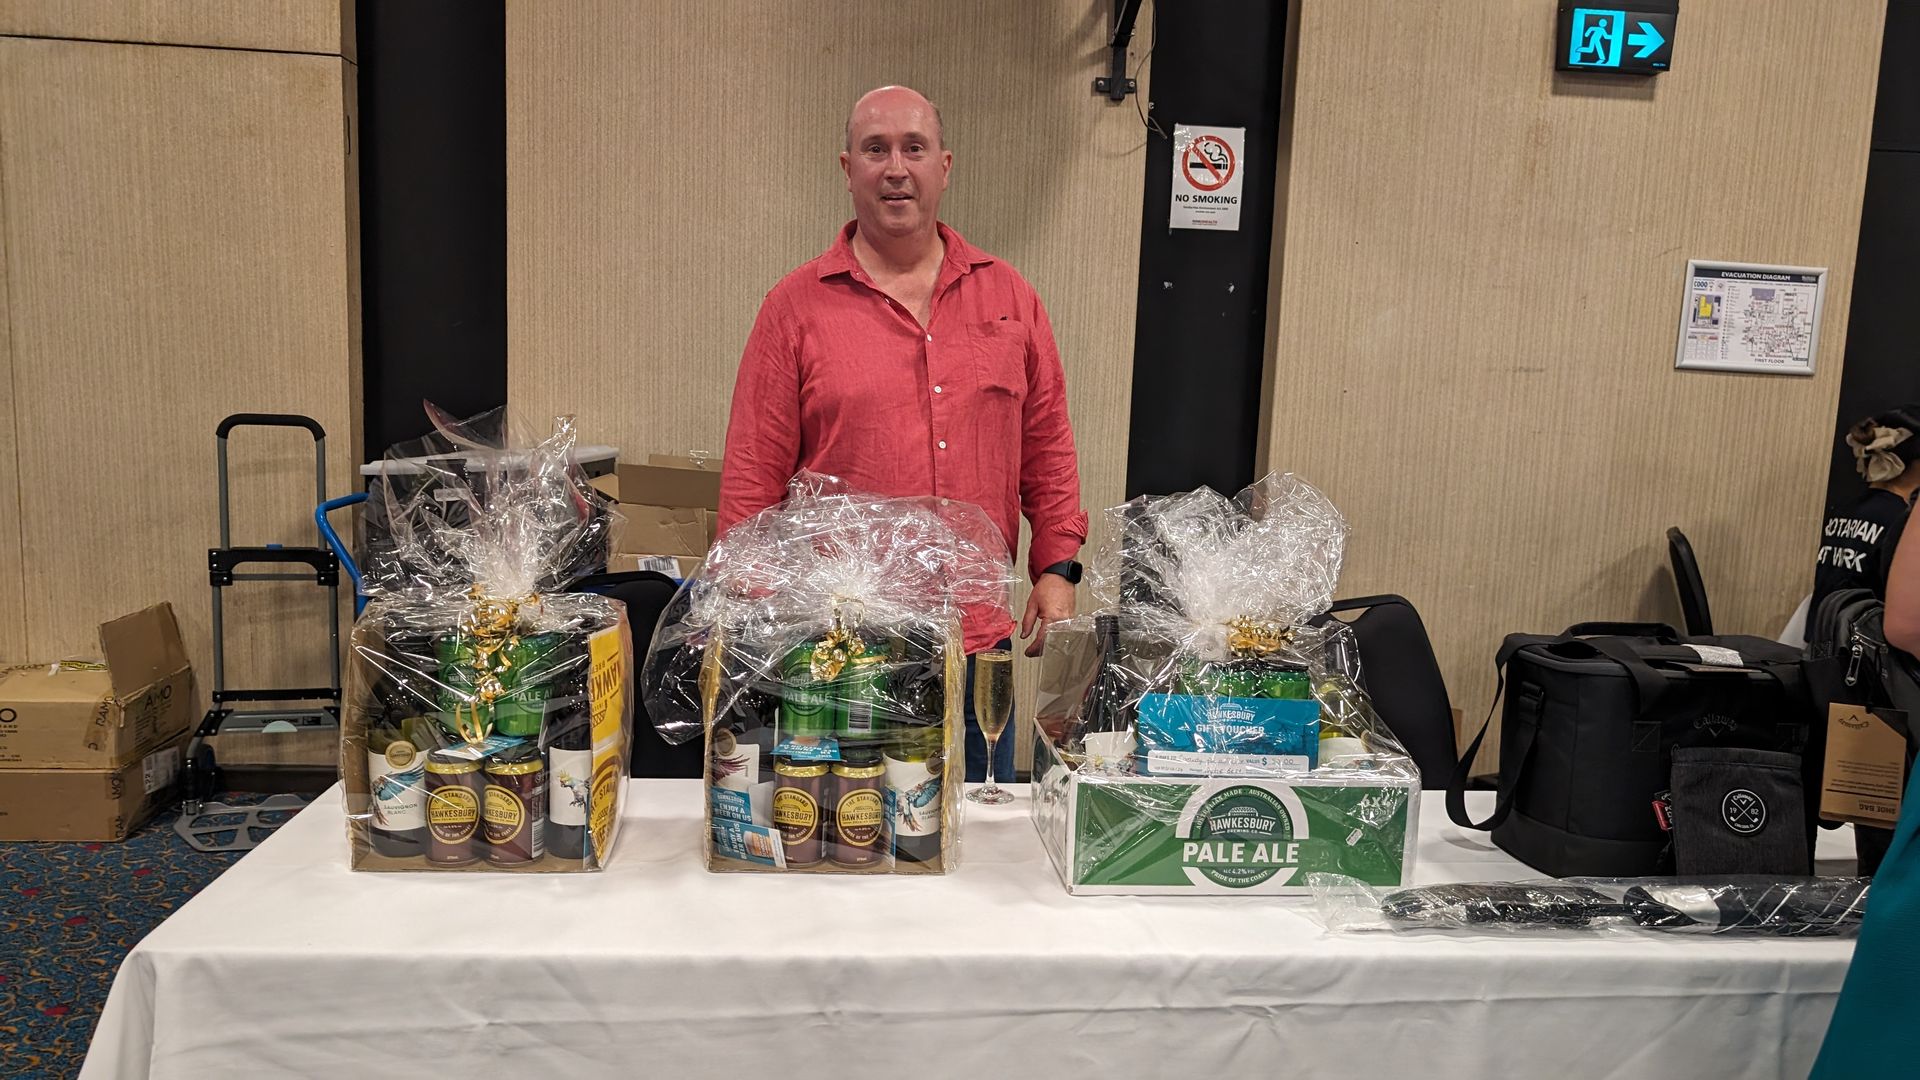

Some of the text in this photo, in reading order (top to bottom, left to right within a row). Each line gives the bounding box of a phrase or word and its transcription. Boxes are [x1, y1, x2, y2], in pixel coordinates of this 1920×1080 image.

[1175, 194, 1238, 204] NO SMOKING
[1721, 271, 1791, 281] EVACUATION DIAGRAM
[1825, 517, 1885, 545] OTARIAN
[1832, 546, 1867, 573] WRK
[512, 692, 542, 701] PALE
[784, 690, 830, 705] PALE ALE
[444, 792, 472, 803] STANDARD
[488, 791, 513, 806] STANDARD
[784, 794, 809, 808] STANDARD
[856, 796, 880, 806] STANDARD
[431, 808, 477, 818] HAWKESBURY
[719, 803, 745, 815] ENJOY A
[1223, 788, 1243, 800] MADE
[1248, 788, 1282, 811] AUSTRALIAN
[1279, 808, 1291, 832] OWNED
[1859, 803, 1875, 811] BAG
[1877, 805, 1896, 815] SHOE
[731, 812, 742, 820] ON
[742, 814, 752, 822] US
[1209, 817, 1276, 832] HAWKESBURY
[1182, 842, 1300, 864] PALE ALE
[1210, 869, 1228, 882] PRIDE
[1250, 870, 1269, 882] COAST
